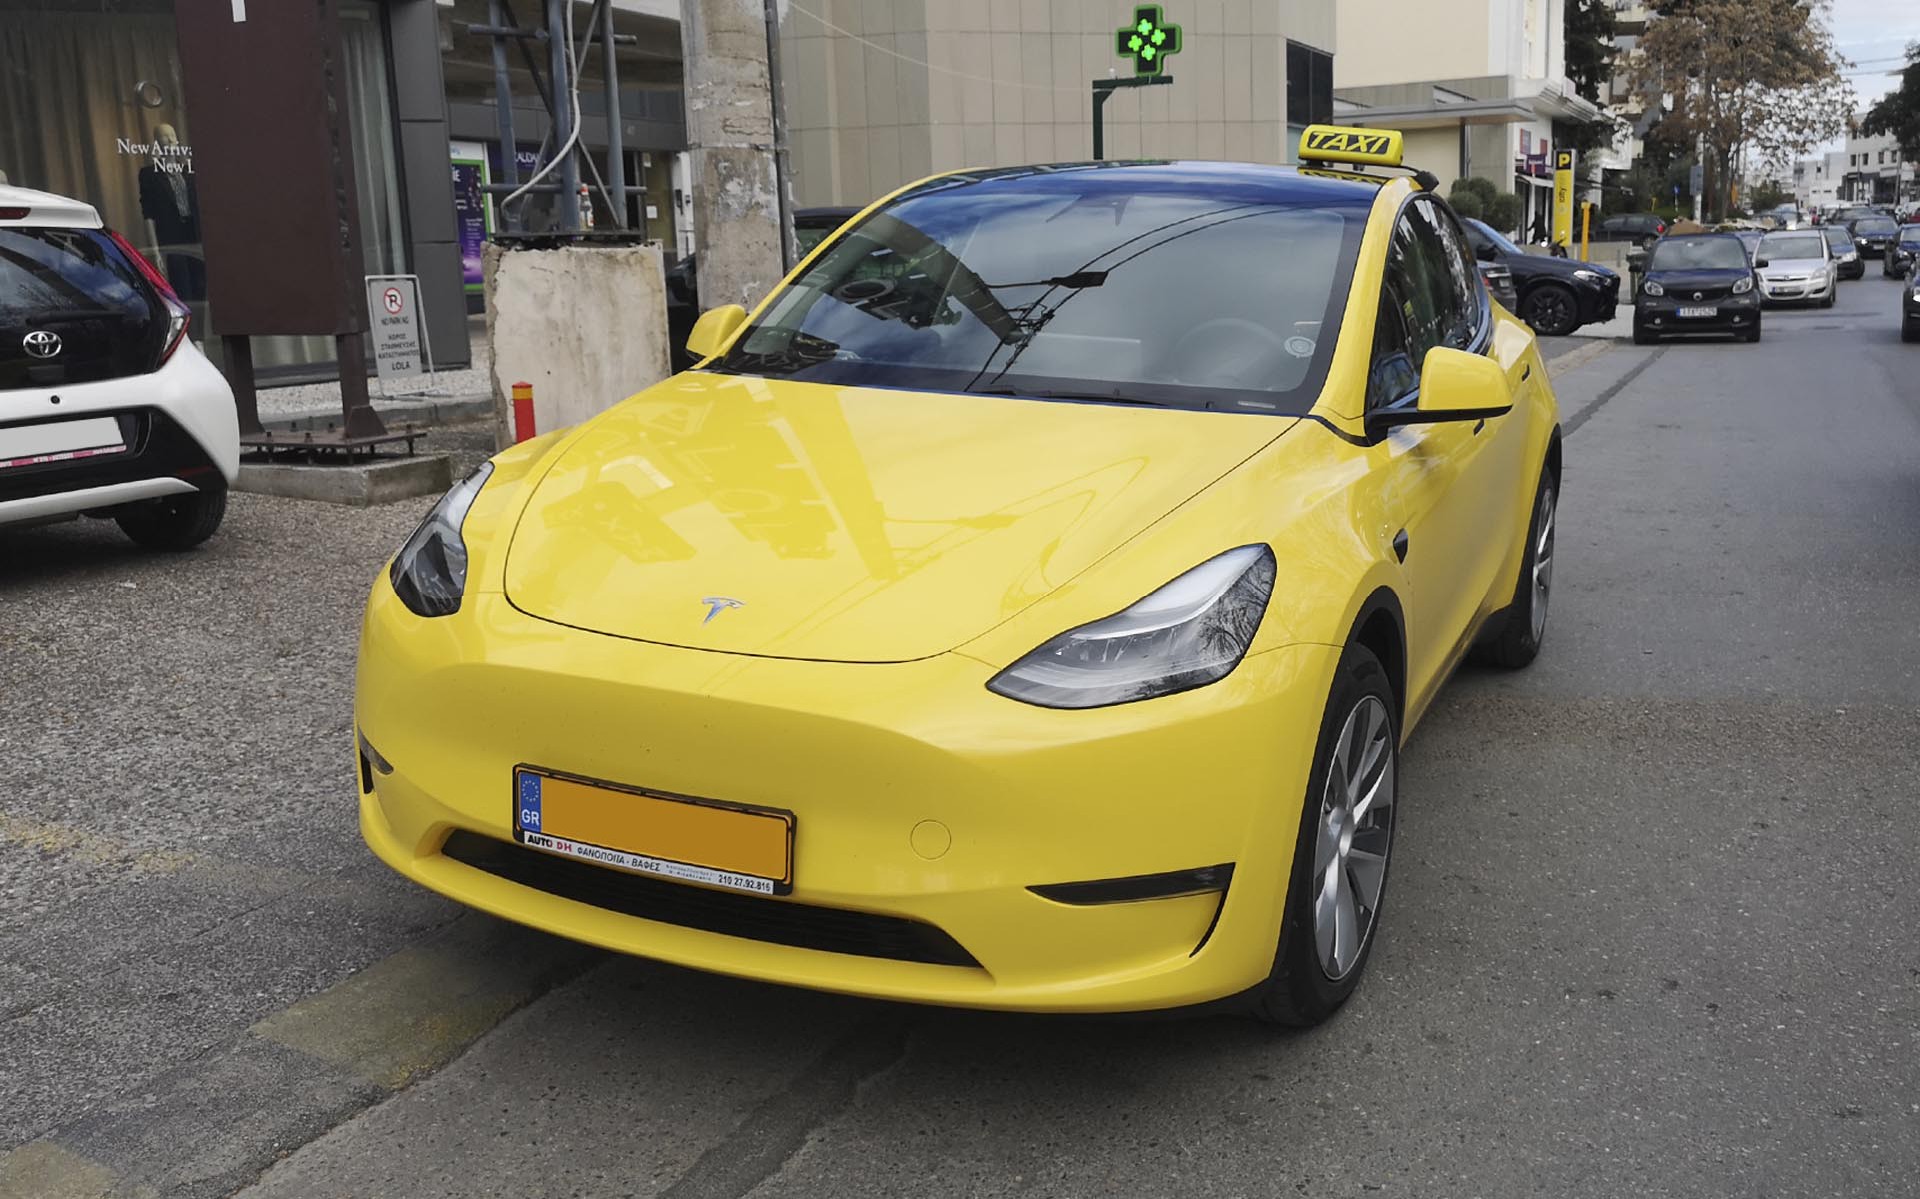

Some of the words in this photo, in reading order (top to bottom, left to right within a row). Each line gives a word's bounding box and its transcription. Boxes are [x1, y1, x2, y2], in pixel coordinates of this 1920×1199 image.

[117, 138, 149, 154] New
[1310, 132, 1387, 153] TAXI
[153, 157, 184, 173] New
[1558, 153, 1570, 168] P
[392, 361, 411, 371] LOLA
[521, 808, 540, 826] GR
[528, 834, 553, 848] AUTO
[631, 858, 661, 872] ΒΑΦΕΣ
